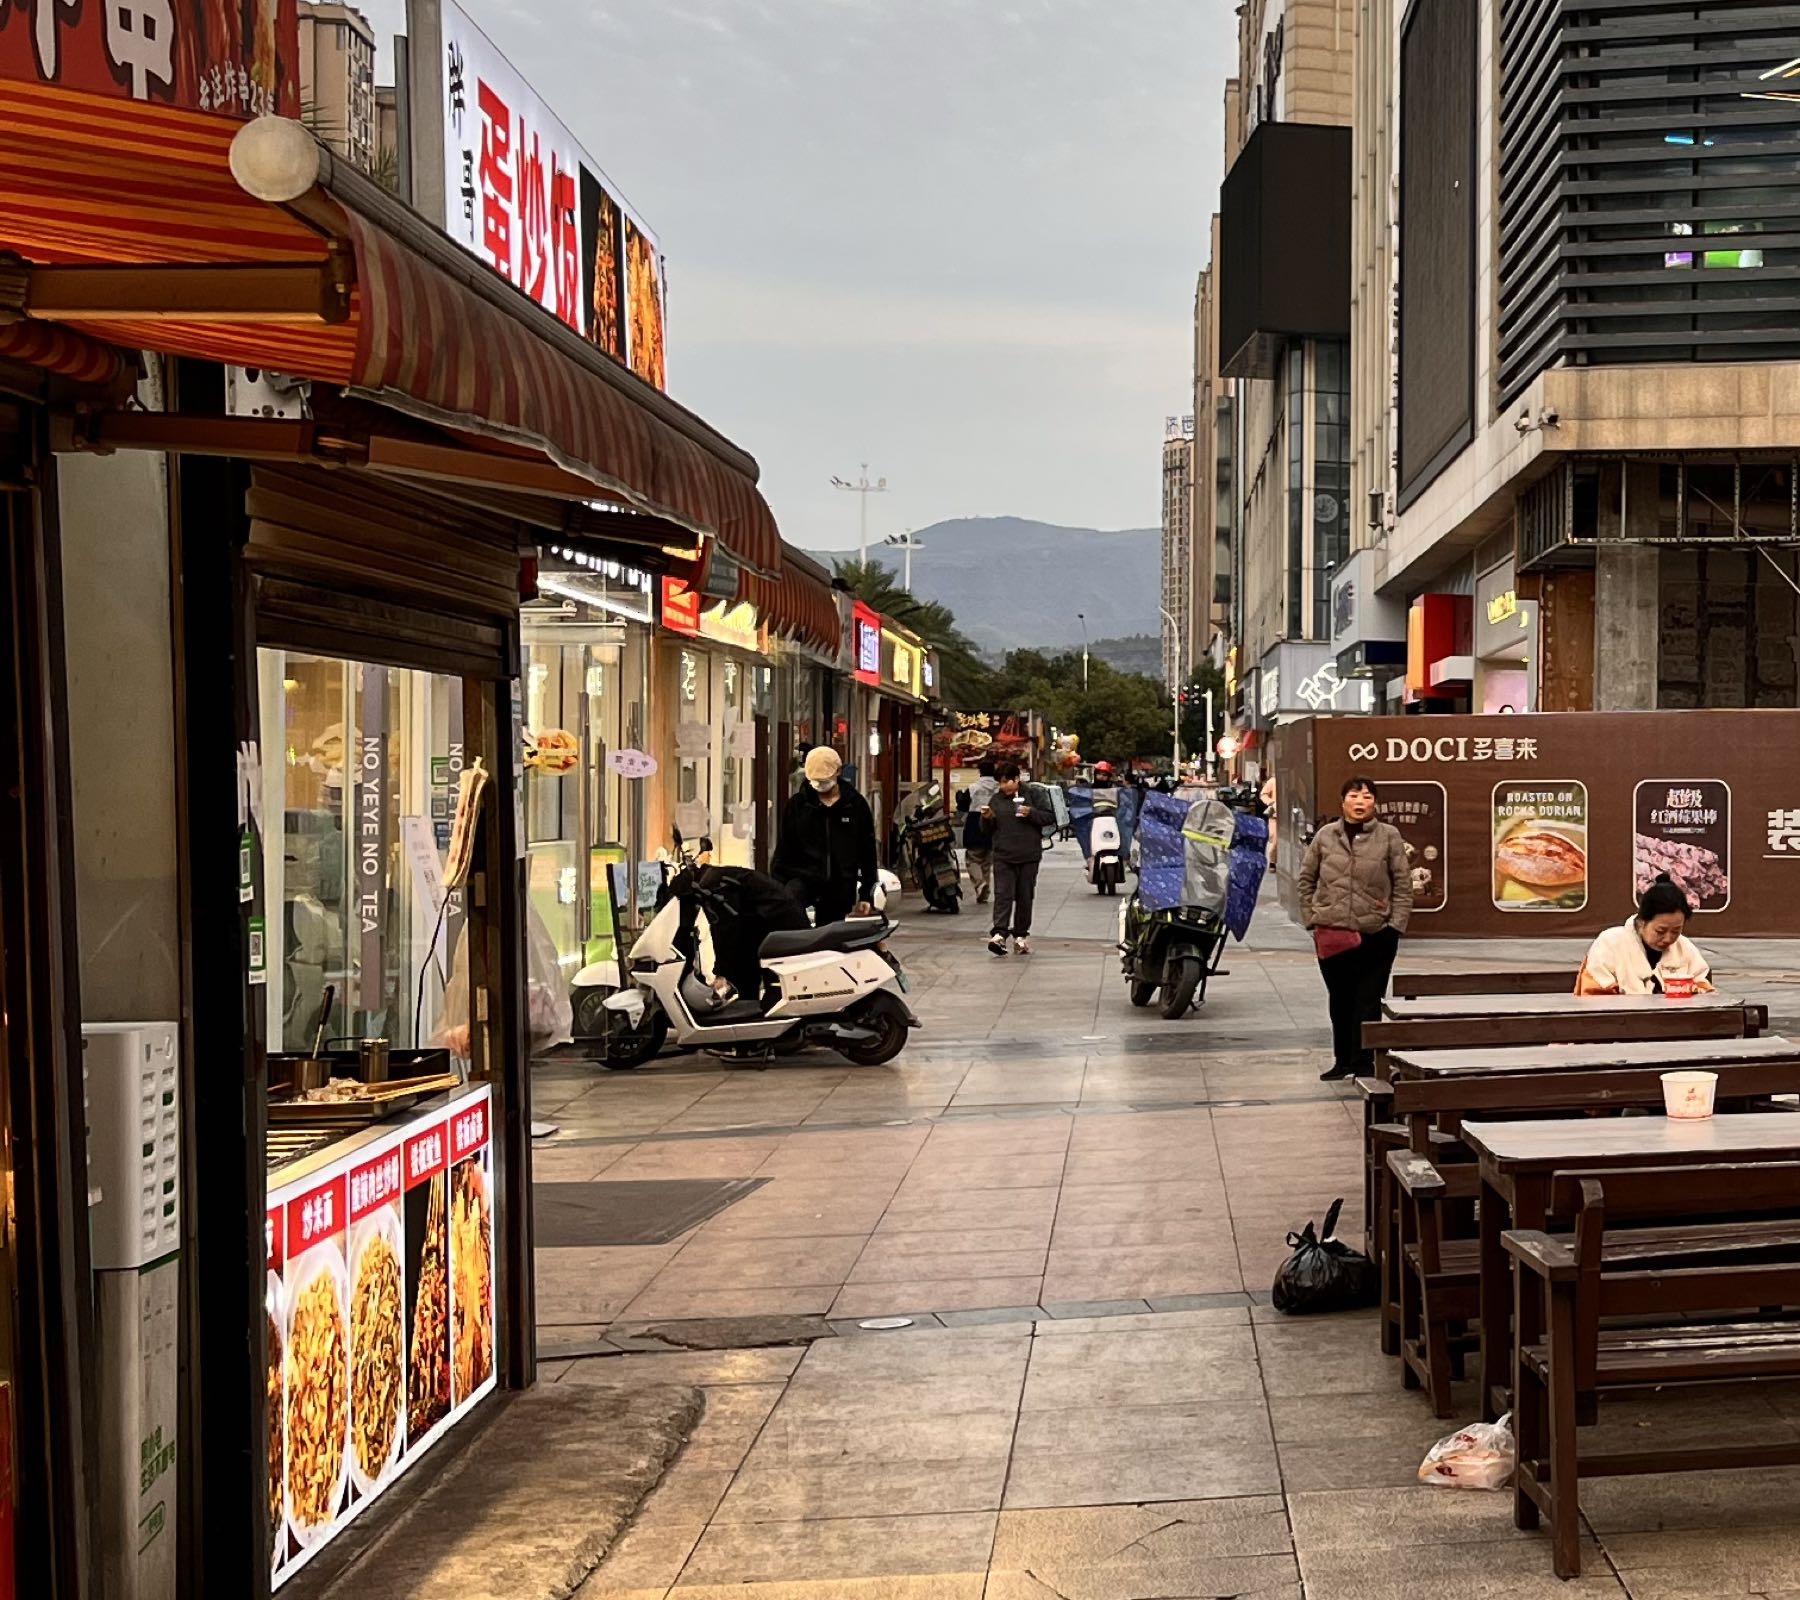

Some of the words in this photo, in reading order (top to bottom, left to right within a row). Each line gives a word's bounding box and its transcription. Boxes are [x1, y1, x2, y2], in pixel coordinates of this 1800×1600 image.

[476, 76, 580, 332] 蛋炒饭
[363, 736, 380, 770] NO
[1386, 735, 1468, 762] DOCI
[1472, 736, 1538, 762] 多喜来
[362, 778, 380, 835] YEYE
[1498, 805, 1536, 817] ROCKS
[1539, 805, 1582, 817] DURIAN
[1507, 791, 1554, 803] ROASTED
[1558, 791, 1573, 802] ON
[362, 843, 380, 876] NO
[361, 890, 379, 933] TEA
